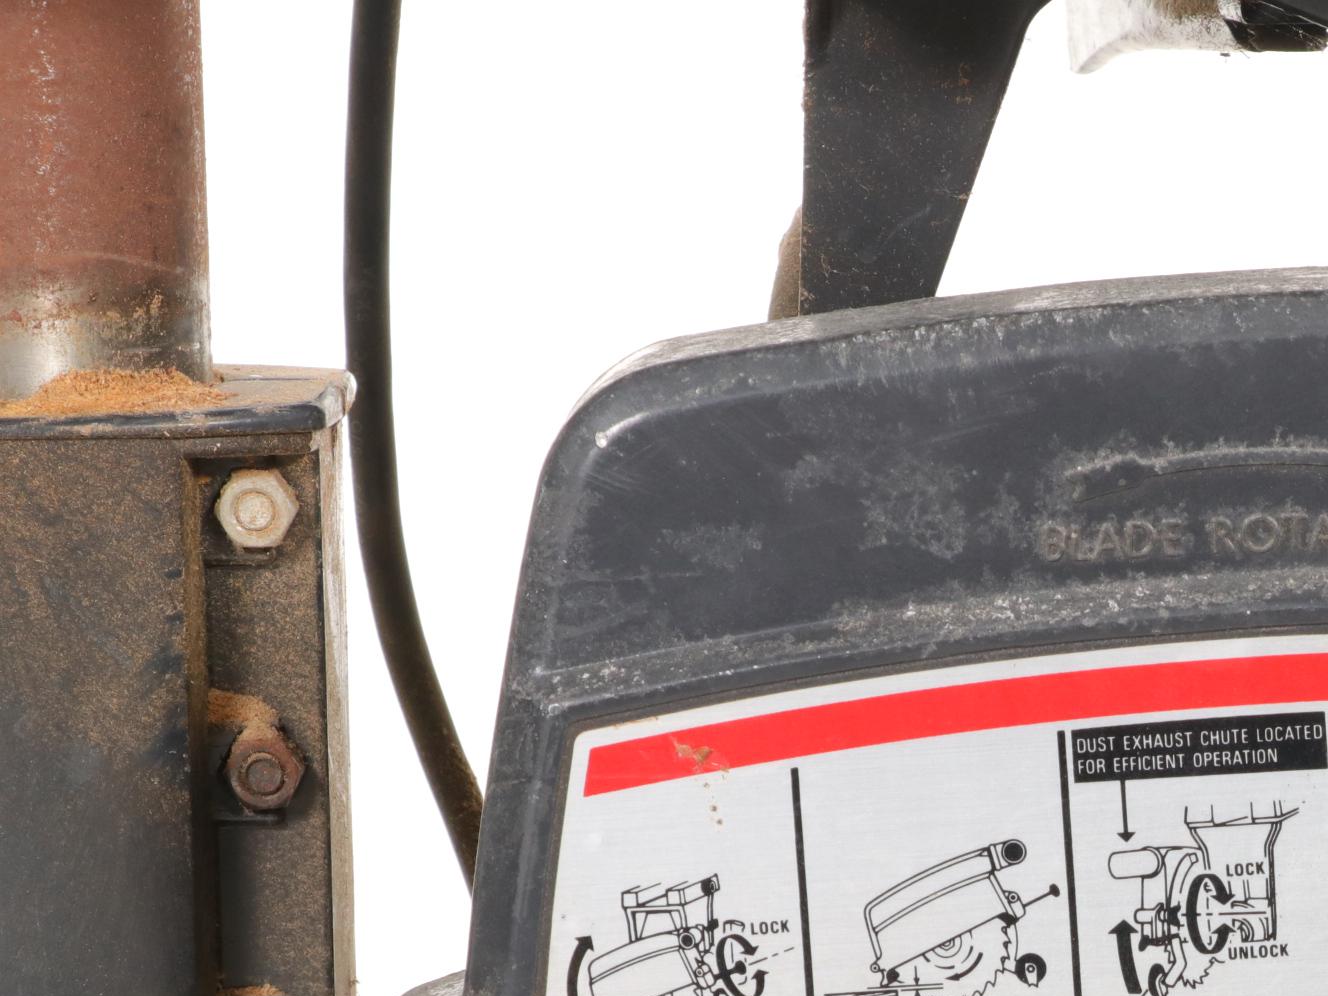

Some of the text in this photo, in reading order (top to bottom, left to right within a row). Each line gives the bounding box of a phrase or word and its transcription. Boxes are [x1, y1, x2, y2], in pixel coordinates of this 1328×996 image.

[1037, 517, 1187, 562] BLADE
[1076, 724, 1323, 754] DUST EXHAUST CHUTE LOCATED
[1077, 748, 1278, 775] FOR EFFICIENT OPERATION
[1225, 861, 1265, 878] LOCK
[750, 919, 790, 936] LOCK
[1227, 943, 1289, 961] UNLOCK
